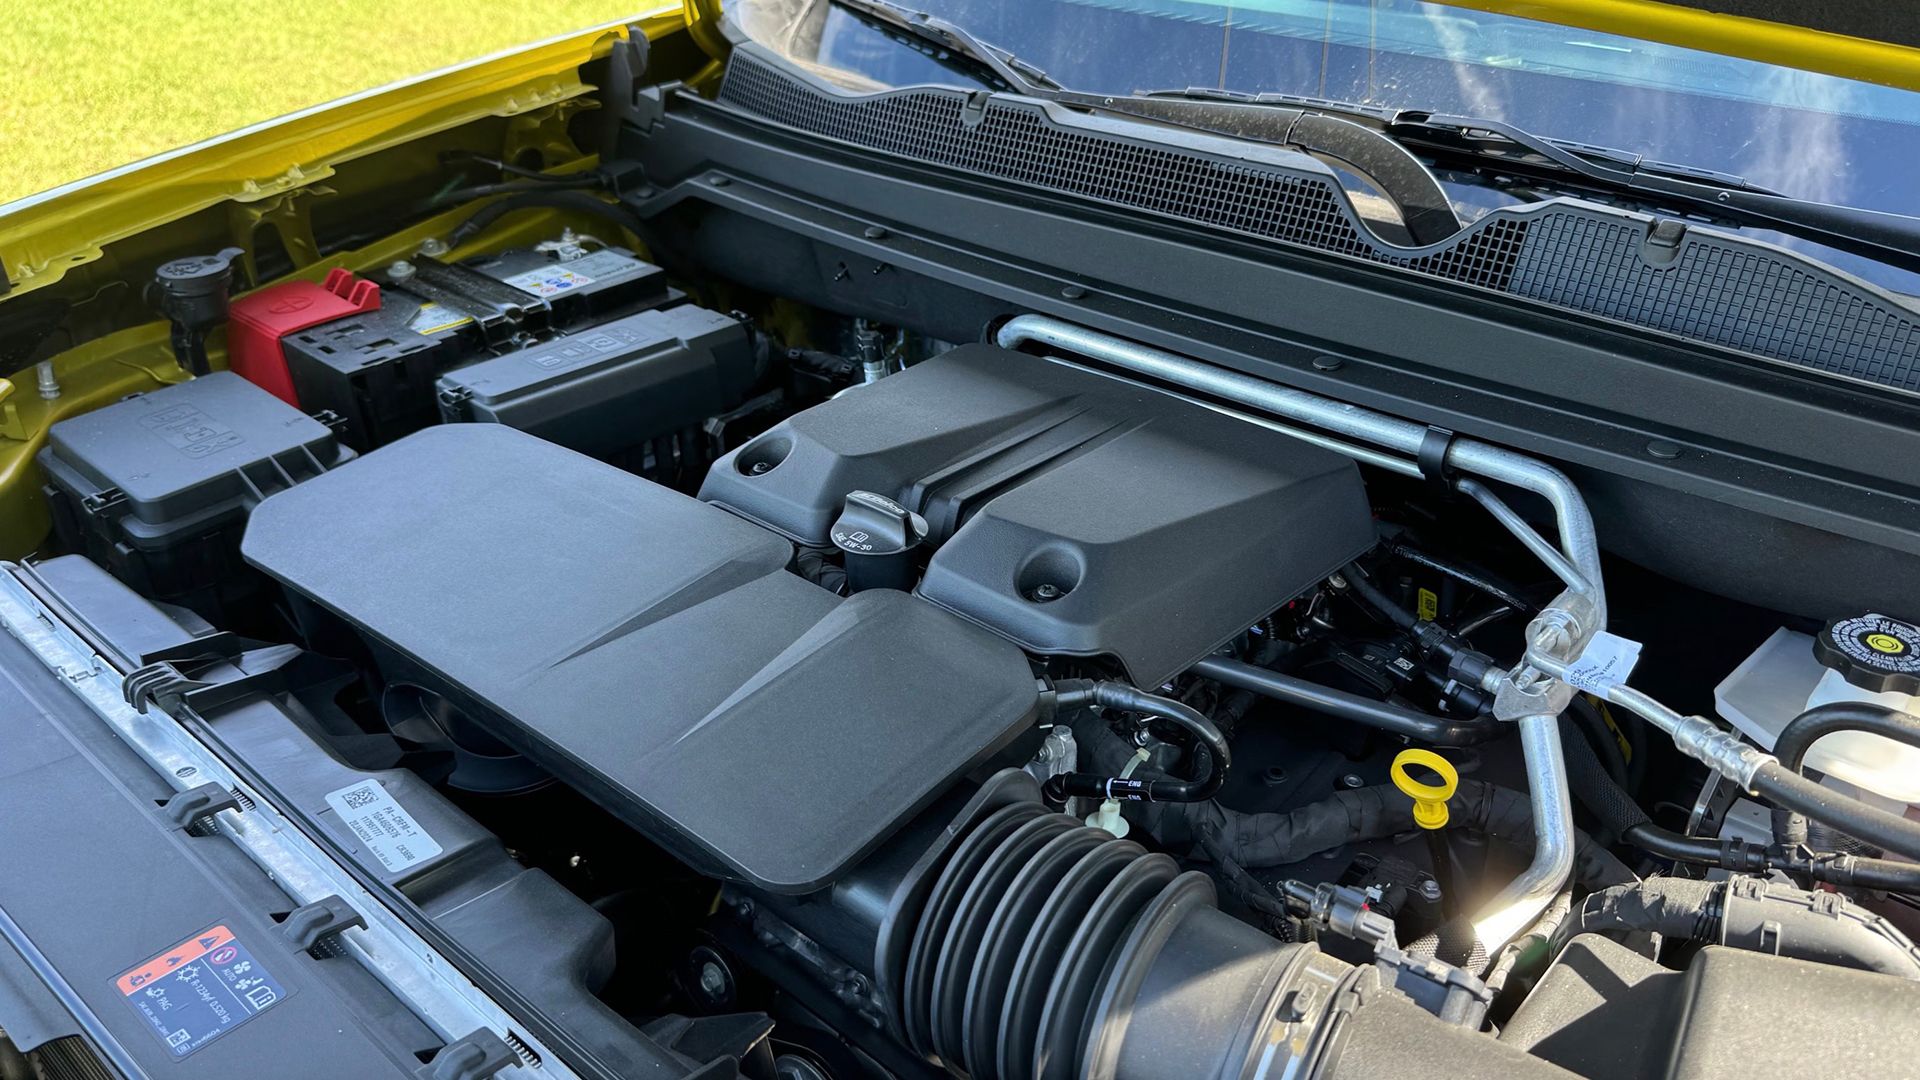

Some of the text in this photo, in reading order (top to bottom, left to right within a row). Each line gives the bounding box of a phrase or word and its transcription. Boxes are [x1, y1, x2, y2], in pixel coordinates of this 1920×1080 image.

[844, 540, 873, 551] 5W-30
[157, 996, 173, 1011] PAG
[191, 979, 232, 1024] R-1234yf 0.520 kg
